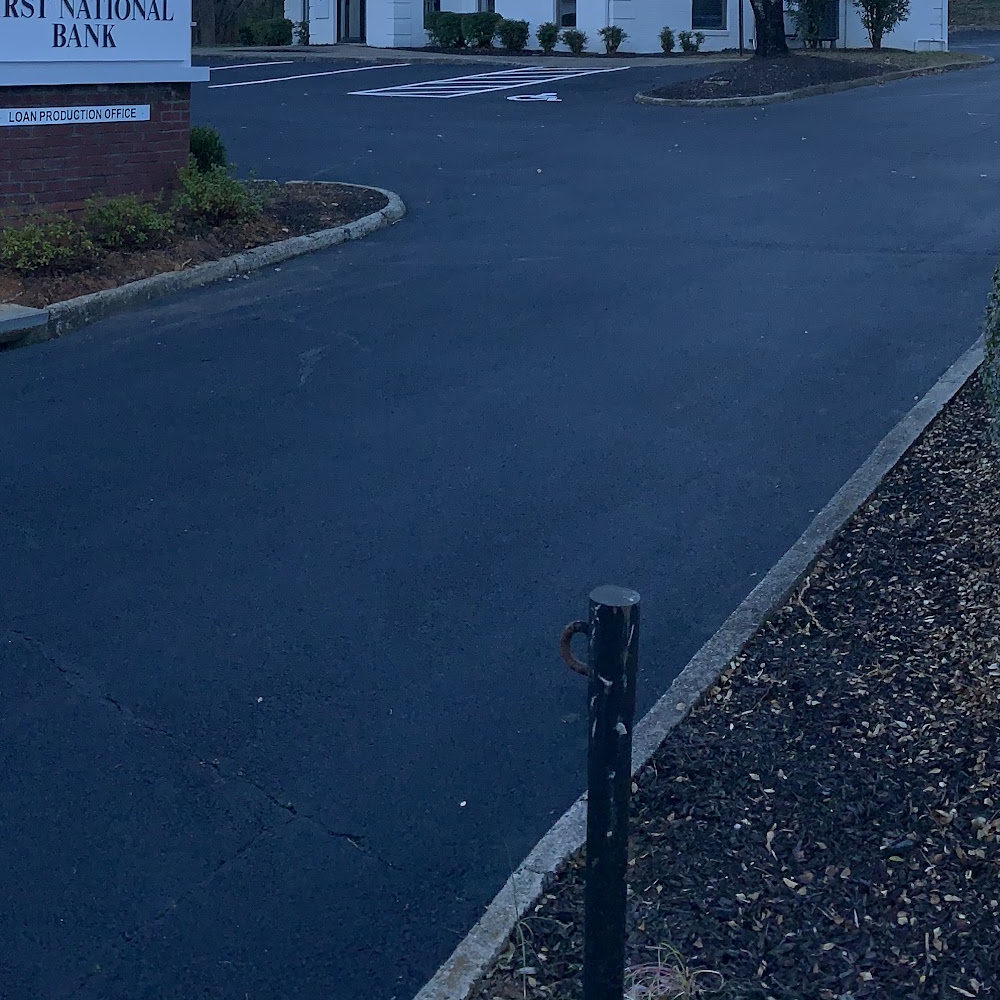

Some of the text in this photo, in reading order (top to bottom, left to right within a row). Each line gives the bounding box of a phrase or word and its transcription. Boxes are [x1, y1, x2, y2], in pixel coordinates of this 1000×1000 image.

[52, 23, 117, 49] BANK
[8, 107, 137, 123] LOAN PRODUCTION OFFICE
